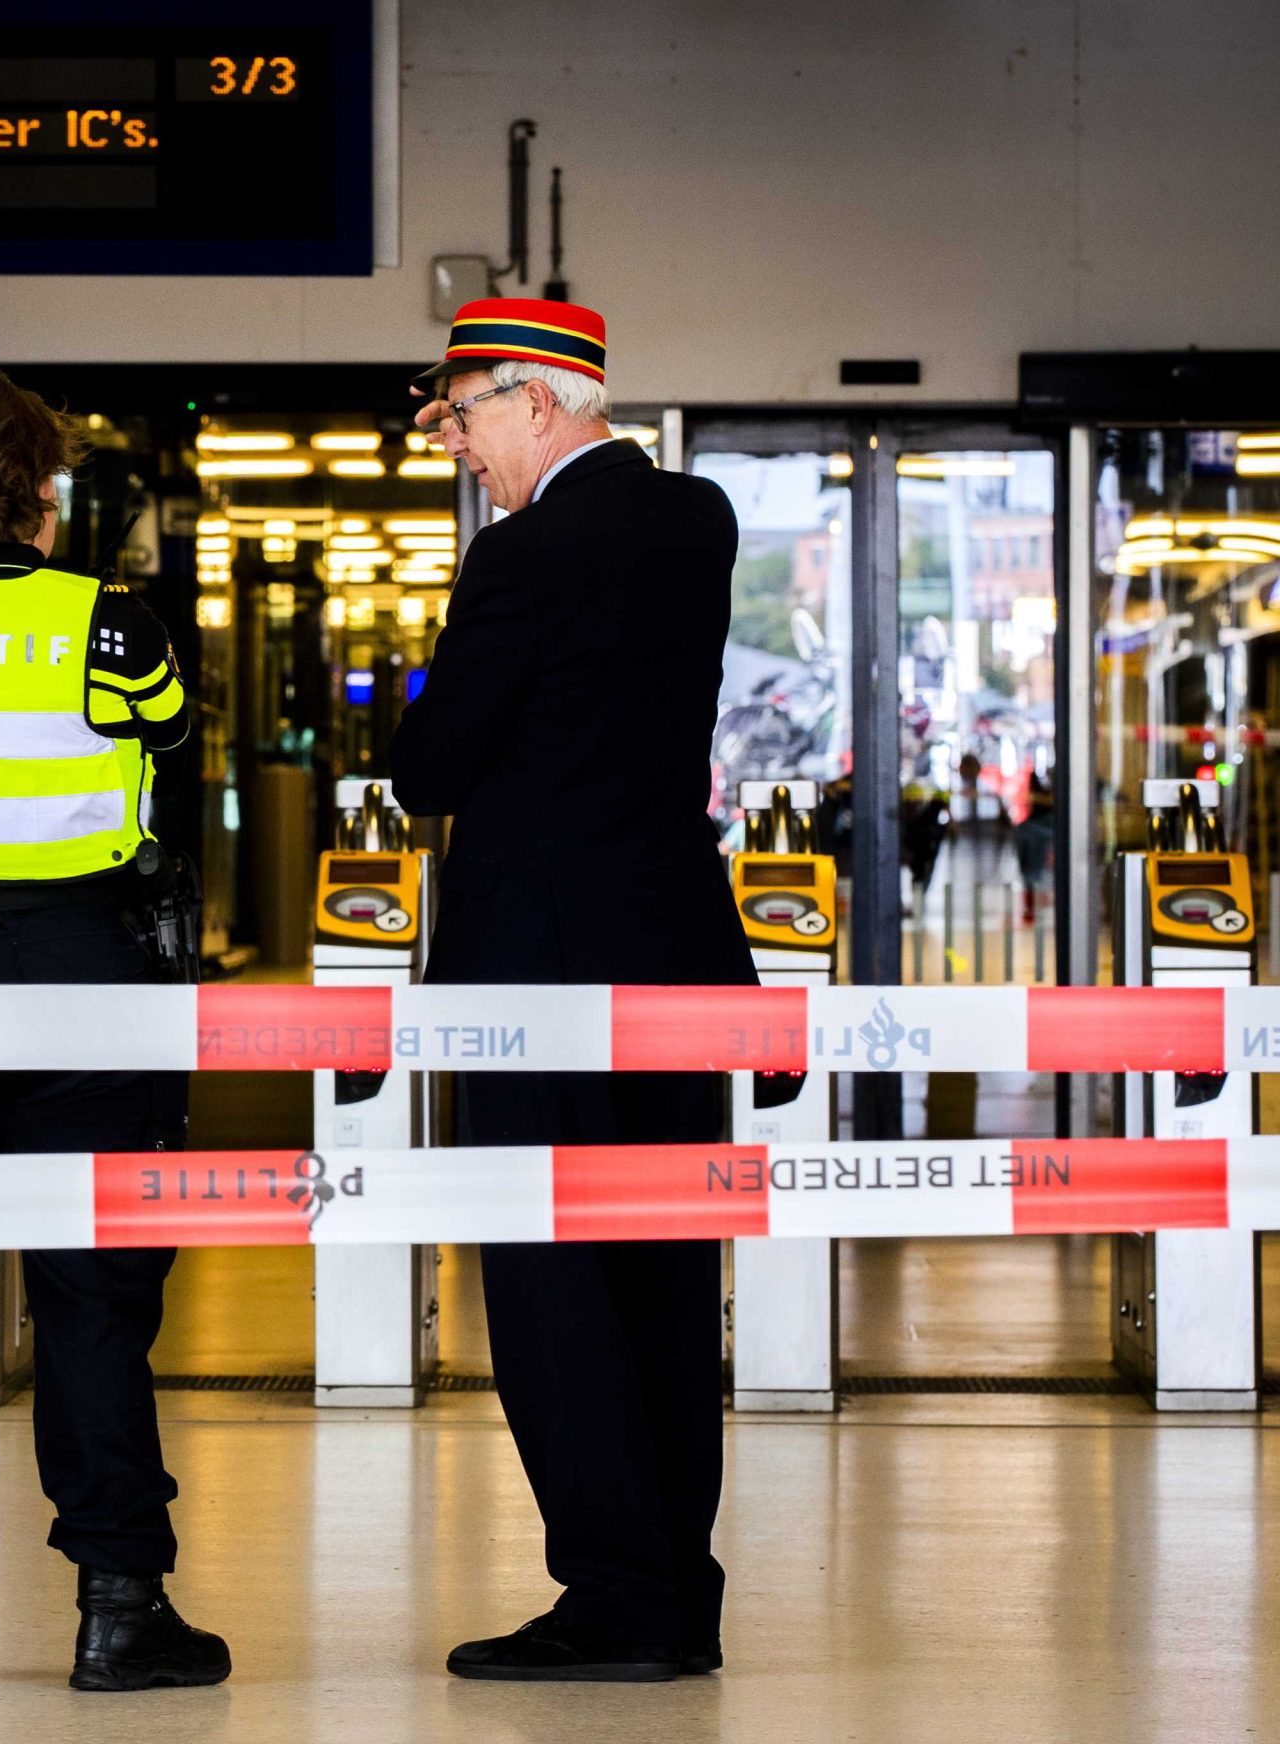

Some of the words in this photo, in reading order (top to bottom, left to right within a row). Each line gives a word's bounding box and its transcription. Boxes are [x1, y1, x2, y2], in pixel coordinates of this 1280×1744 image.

[210, 56, 297, 96] 3/3
[66, 110, 159, 149] IC's.
[706, 1156, 953, 1192] BETREDEN
[970, 1154, 1071, 1188] NIET
